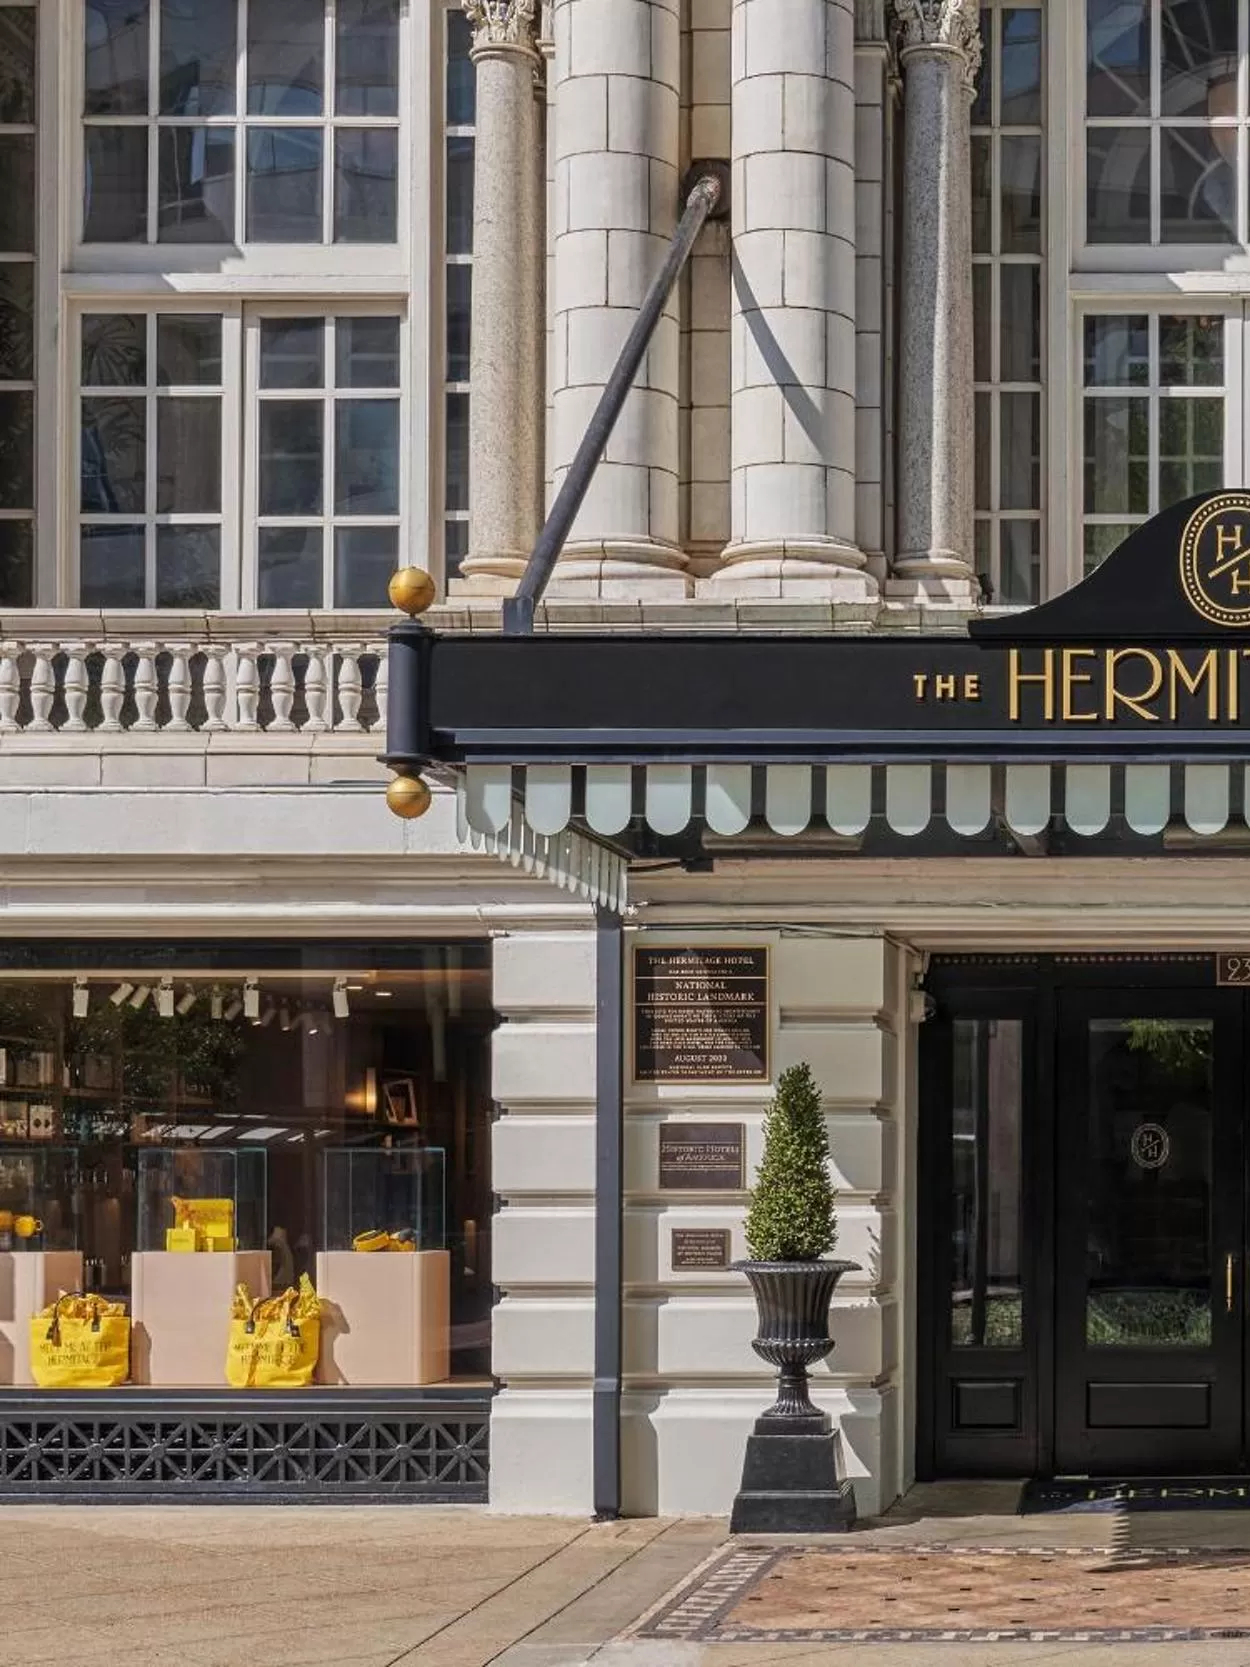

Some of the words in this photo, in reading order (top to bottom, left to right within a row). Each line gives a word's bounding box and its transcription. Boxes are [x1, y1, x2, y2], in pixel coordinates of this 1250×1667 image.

[913, 673, 980, 700] THE
[675, 981, 727, 990] NATIONAL
[647, 992, 695, 1001] HISTORIC
[698, 992, 755, 1001] LANDMARK
[674, 1054, 708, 1063] AUGUST
